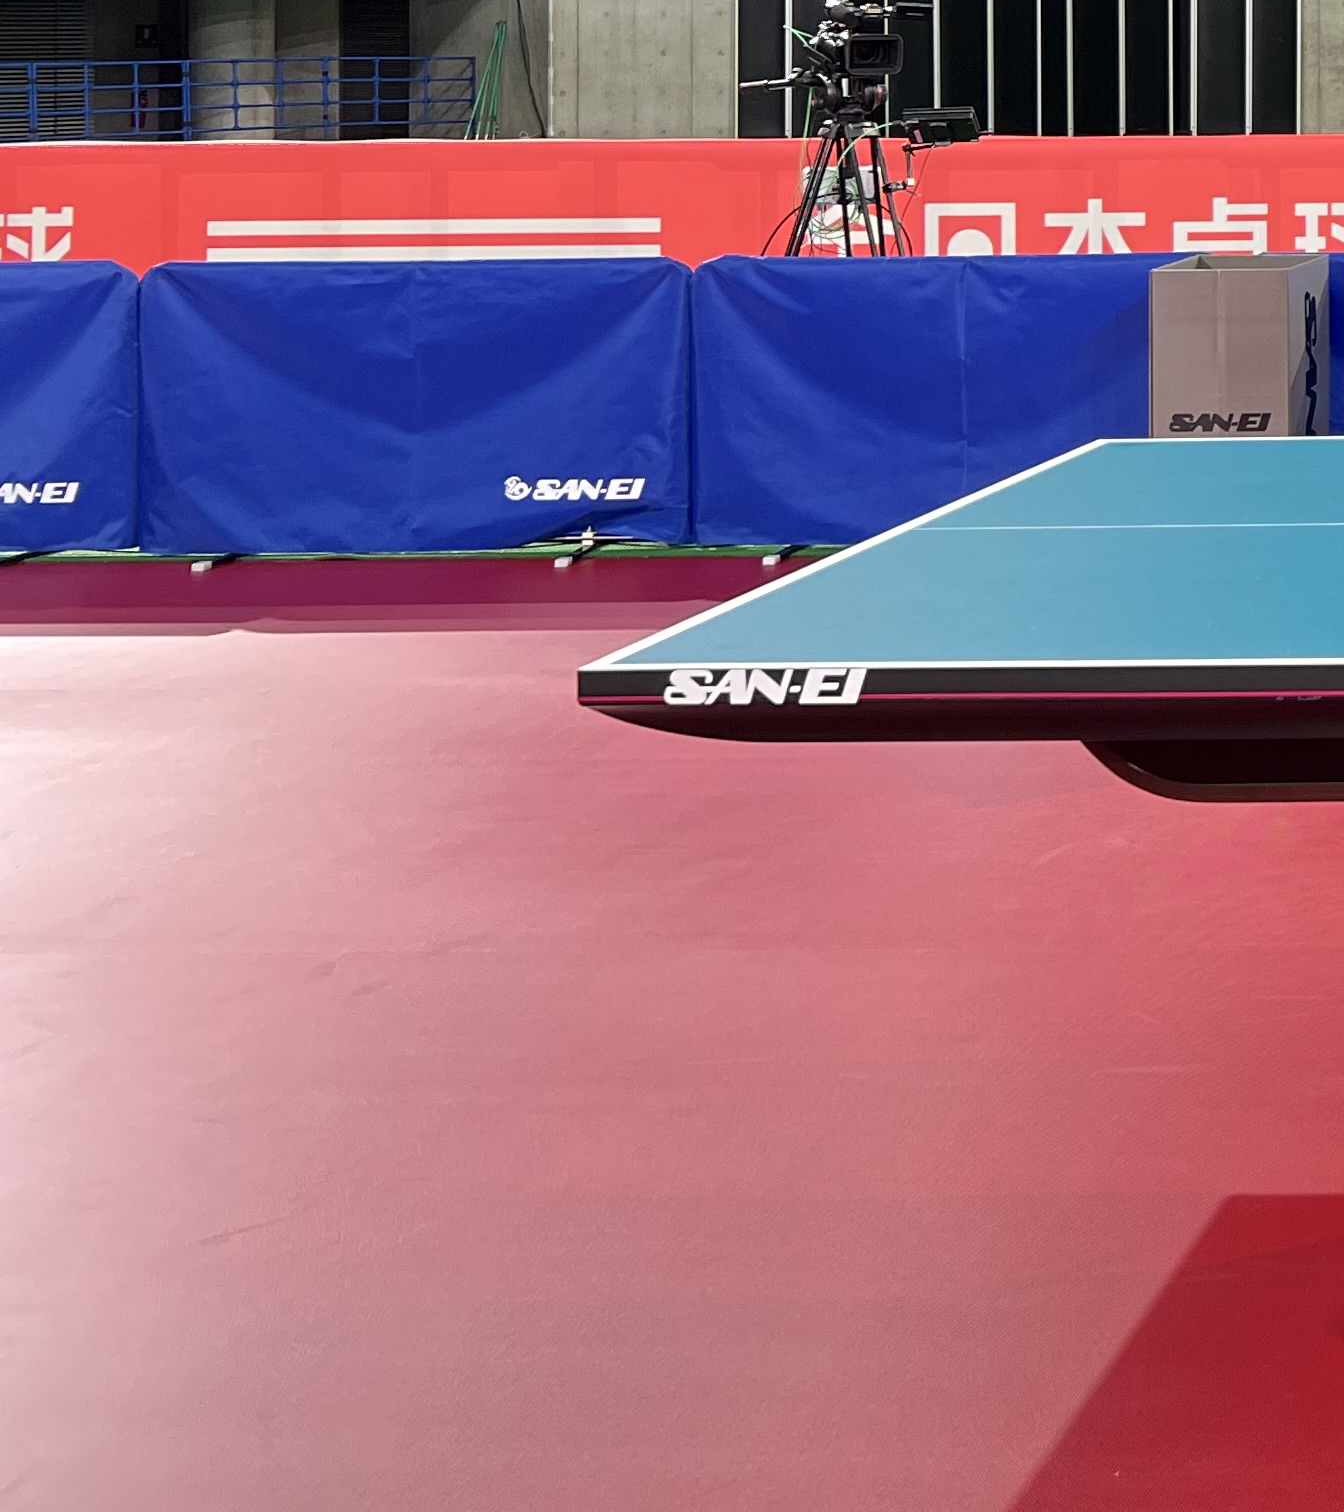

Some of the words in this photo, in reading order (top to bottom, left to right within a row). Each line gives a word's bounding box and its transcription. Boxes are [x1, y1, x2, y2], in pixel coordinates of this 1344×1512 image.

[1169, 412, 1272, 432] SAN-EI
[532, 478, 646, 501] SAN-EI
[663, 668, 868, 705] SAN-EI
